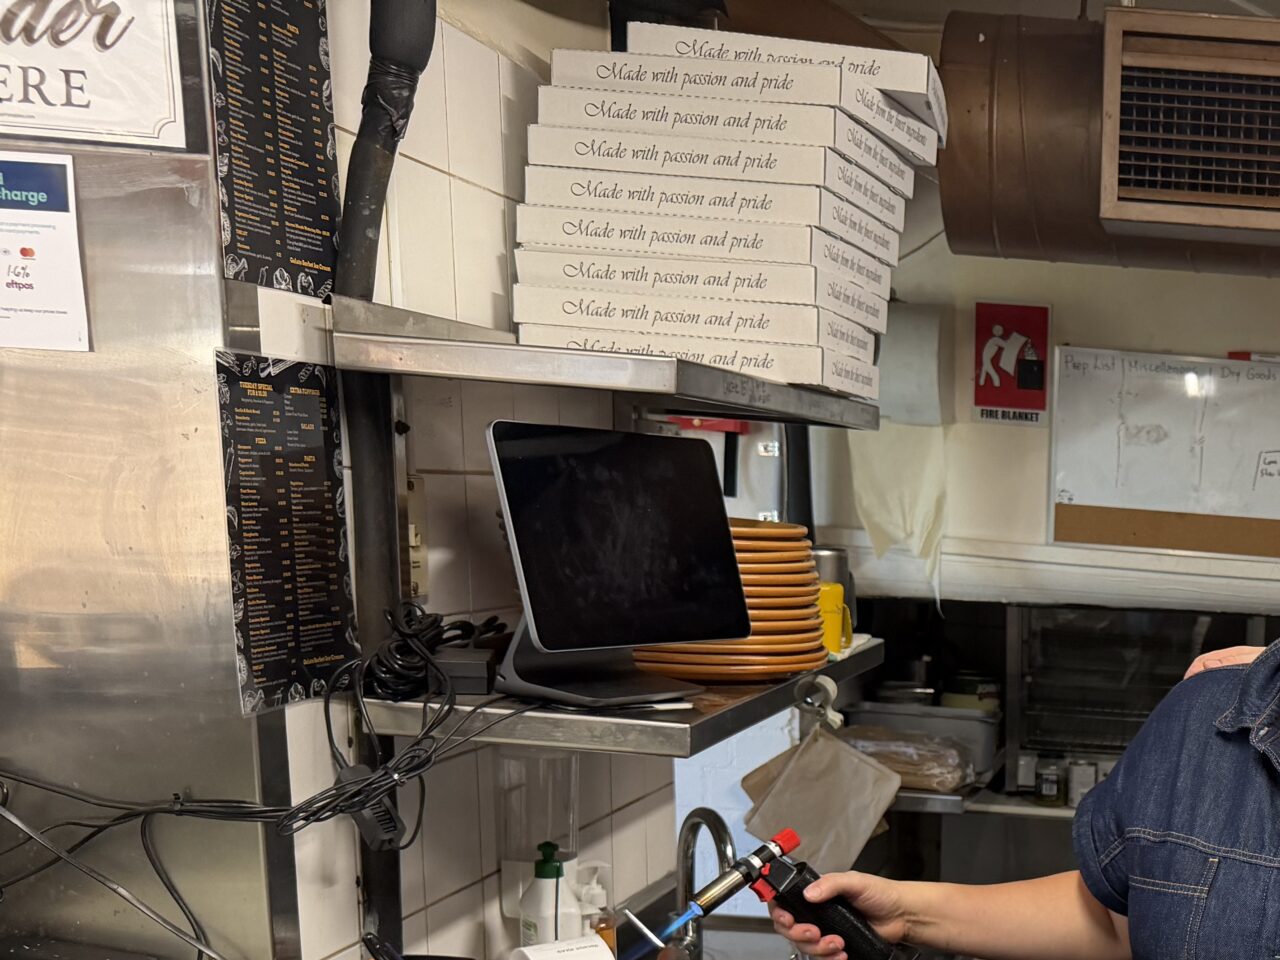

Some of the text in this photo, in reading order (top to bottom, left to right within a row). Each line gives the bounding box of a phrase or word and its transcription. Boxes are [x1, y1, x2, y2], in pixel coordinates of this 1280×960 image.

[675, 39, 729, 60] Made
[734, 47, 761, 62] with
[596, 62, 794, 94] Made with passion and pride
[584, 100, 788, 135] Made with passion and pride
[575, 139, 778, 174] Made with passion and pride
[570, 180, 773, 214] Made with passion and pride
[562, 219, 764, 253] Made with passion and pride
[5, 280, 34, 292] eftpos
[562, 261, 768, 293] Made with passion and pride
[562, 299, 770, 333] Made with passion and pride
[566, 339, 621, 353] Made
[659, 348, 704, 363] passion
[708, 350, 736, 366] and
[739, 353, 774, 371] pride
[1093, 355, 1116, 371] List
[981, 408, 1039, 422] FIRE BLANKET
